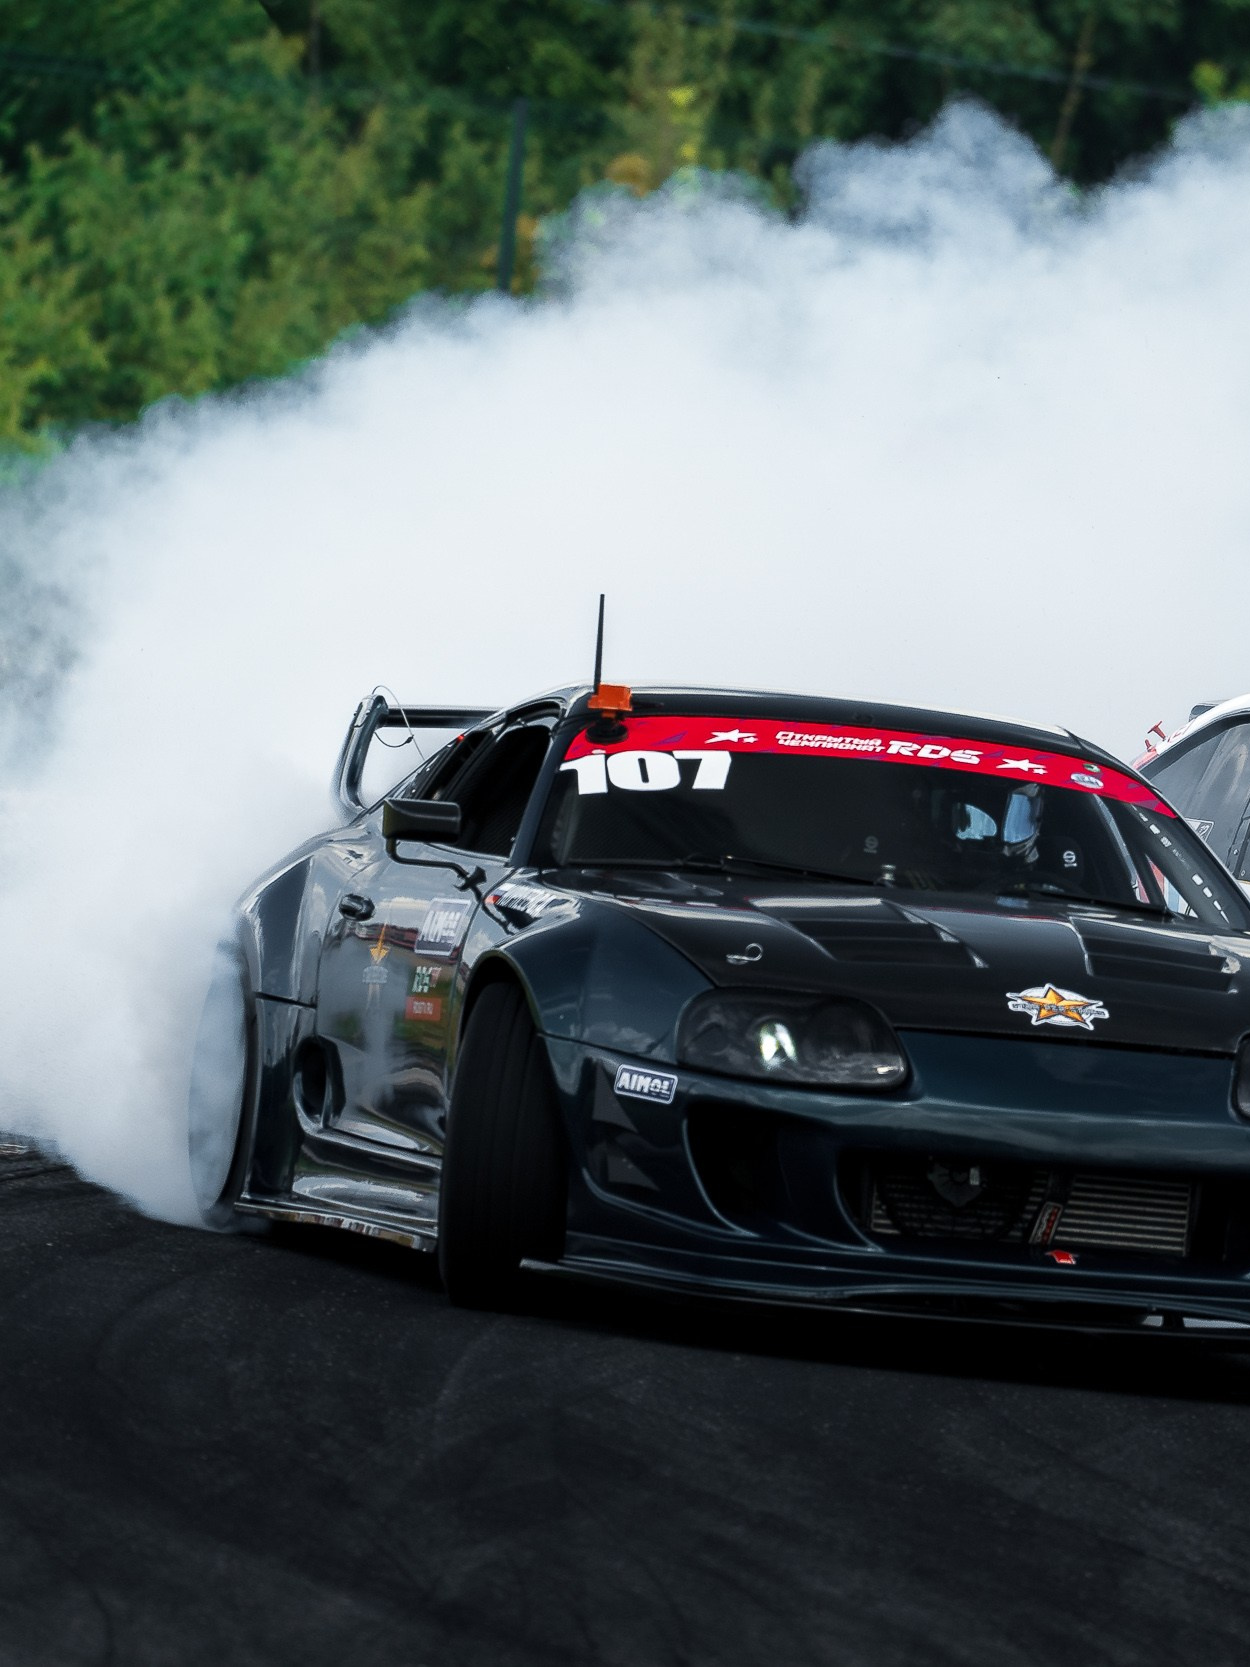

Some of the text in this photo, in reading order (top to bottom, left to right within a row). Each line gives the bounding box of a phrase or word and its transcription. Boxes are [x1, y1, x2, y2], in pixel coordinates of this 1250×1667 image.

[886, 740, 984, 765] RDS
[559, 749, 732, 795] 107
[617, 1071, 671, 1099] AIMOL
